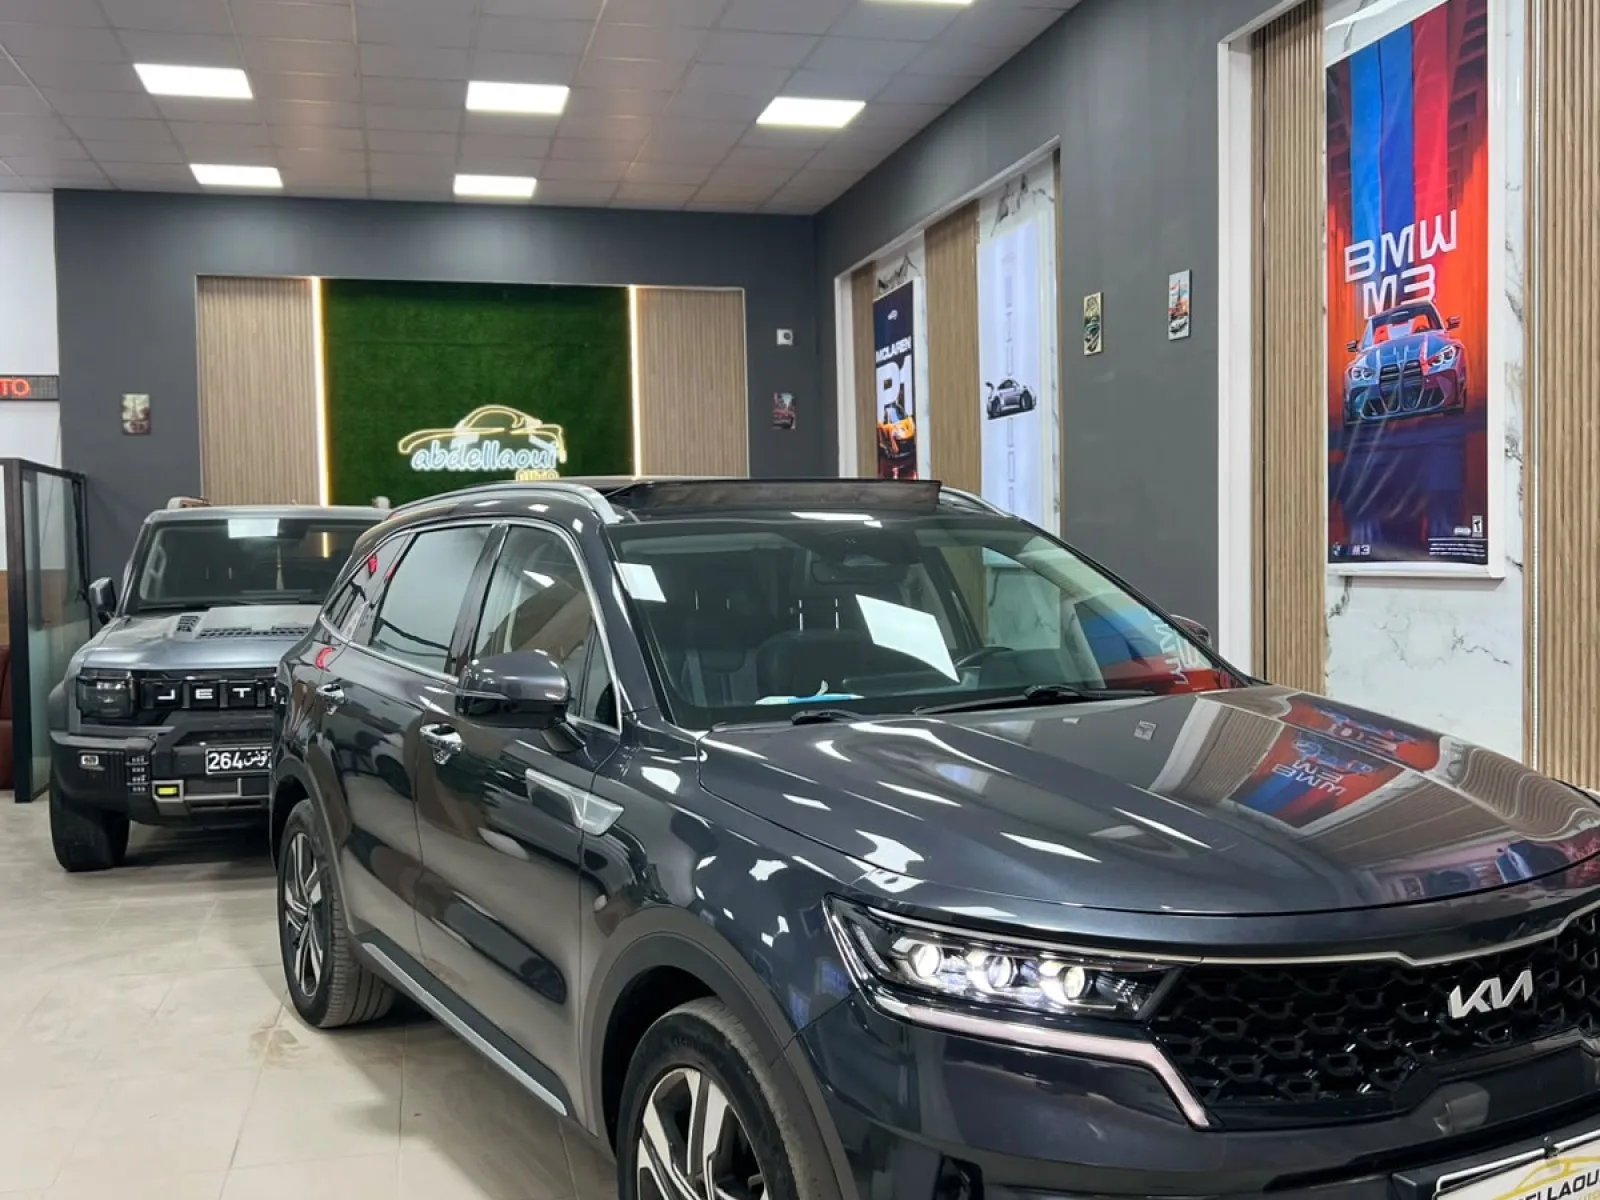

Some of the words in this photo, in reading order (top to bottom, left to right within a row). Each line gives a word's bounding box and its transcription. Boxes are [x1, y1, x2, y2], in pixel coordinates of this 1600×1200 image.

[1344, 209, 1457, 284] BMW
[1362, 263, 1437, 320] M3
[411, 439, 557, 471] abdellaoui
[157, 686, 277, 701] JET
[208, 751, 243, 770] 264
[1449, 968, 1534, 1020] KIA
